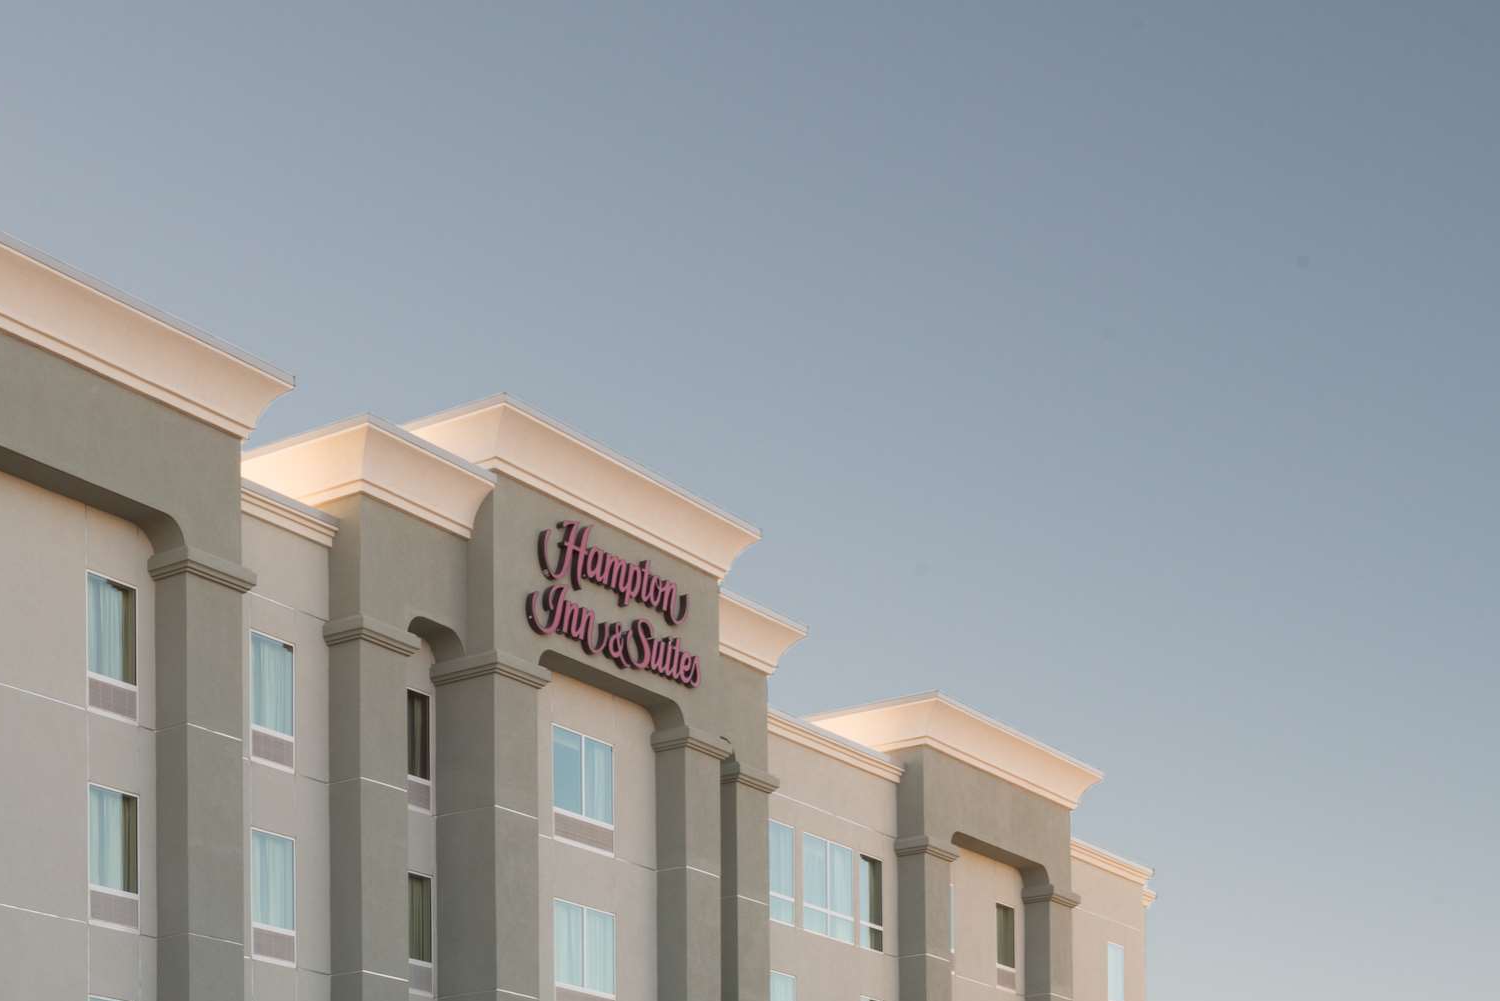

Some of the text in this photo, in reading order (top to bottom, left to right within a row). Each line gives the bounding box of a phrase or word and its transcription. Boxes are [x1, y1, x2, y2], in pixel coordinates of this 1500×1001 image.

[538, 519, 689, 626] Hampton
[525, 583, 700, 688] Inn & Suites
